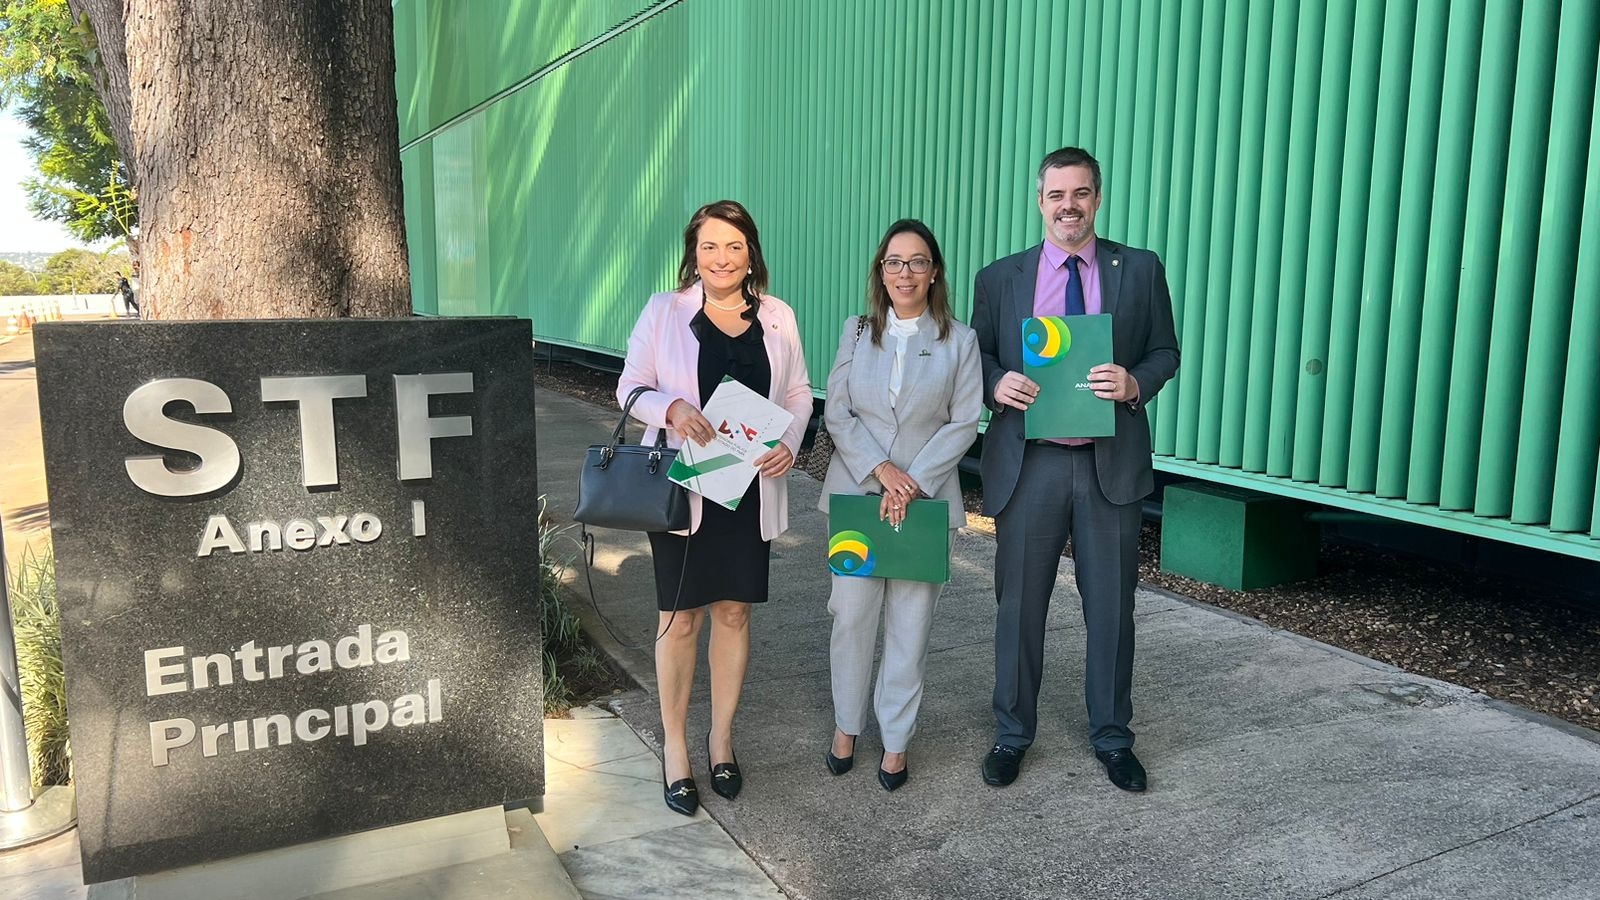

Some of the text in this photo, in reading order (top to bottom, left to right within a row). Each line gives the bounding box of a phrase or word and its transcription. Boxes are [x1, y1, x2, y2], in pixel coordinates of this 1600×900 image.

[122, 372, 474, 497] STF
[197, 500, 426, 556] Anexo I
[143, 623, 410, 697] Entrada
[148, 678, 443, 767] Principal
